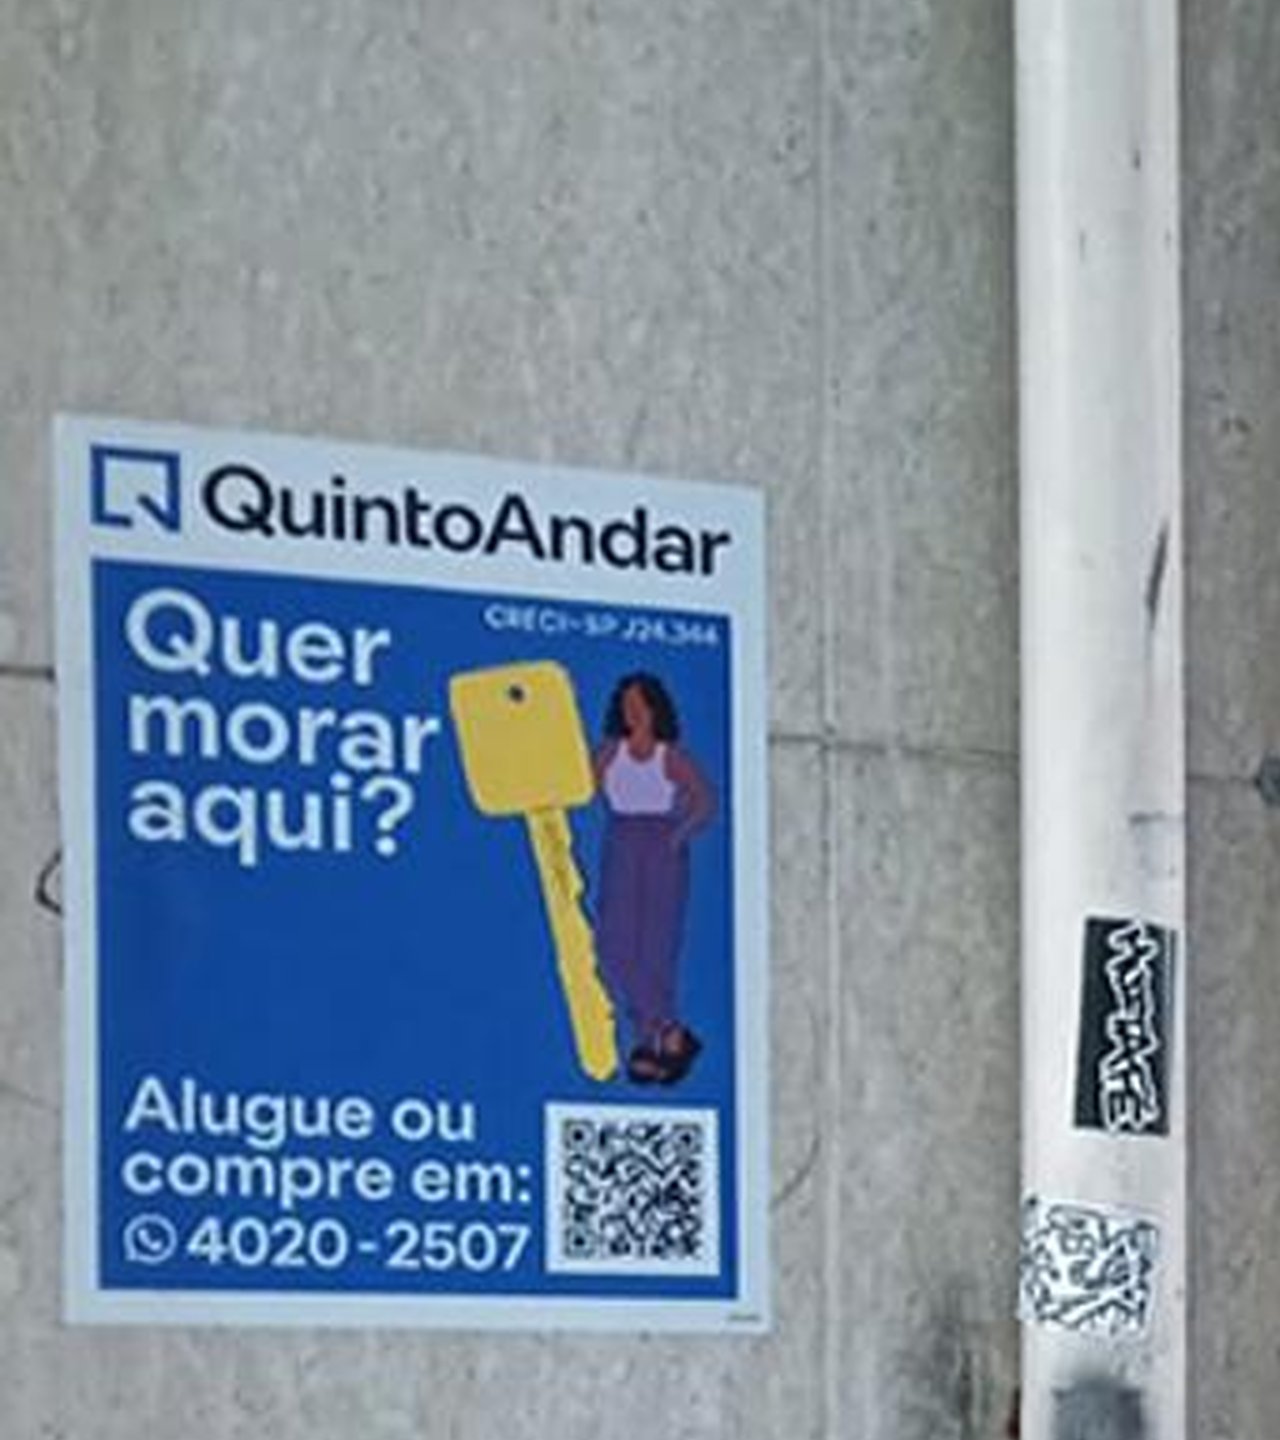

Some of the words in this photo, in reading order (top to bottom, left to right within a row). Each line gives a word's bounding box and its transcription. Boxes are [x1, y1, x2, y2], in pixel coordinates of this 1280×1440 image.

[201, 465, 731, 577] QuintoAndar
[126, 589, 390, 685] Quer
[128, 694, 441, 773] morar
[128, 773, 413, 866] aqui?
[123, 1076, 374, 1149] Alugue
[392, 1099, 476, 1141] ou
[122, 1152, 395, 1210] compre
[411, 1160, 532, 1204] em:
